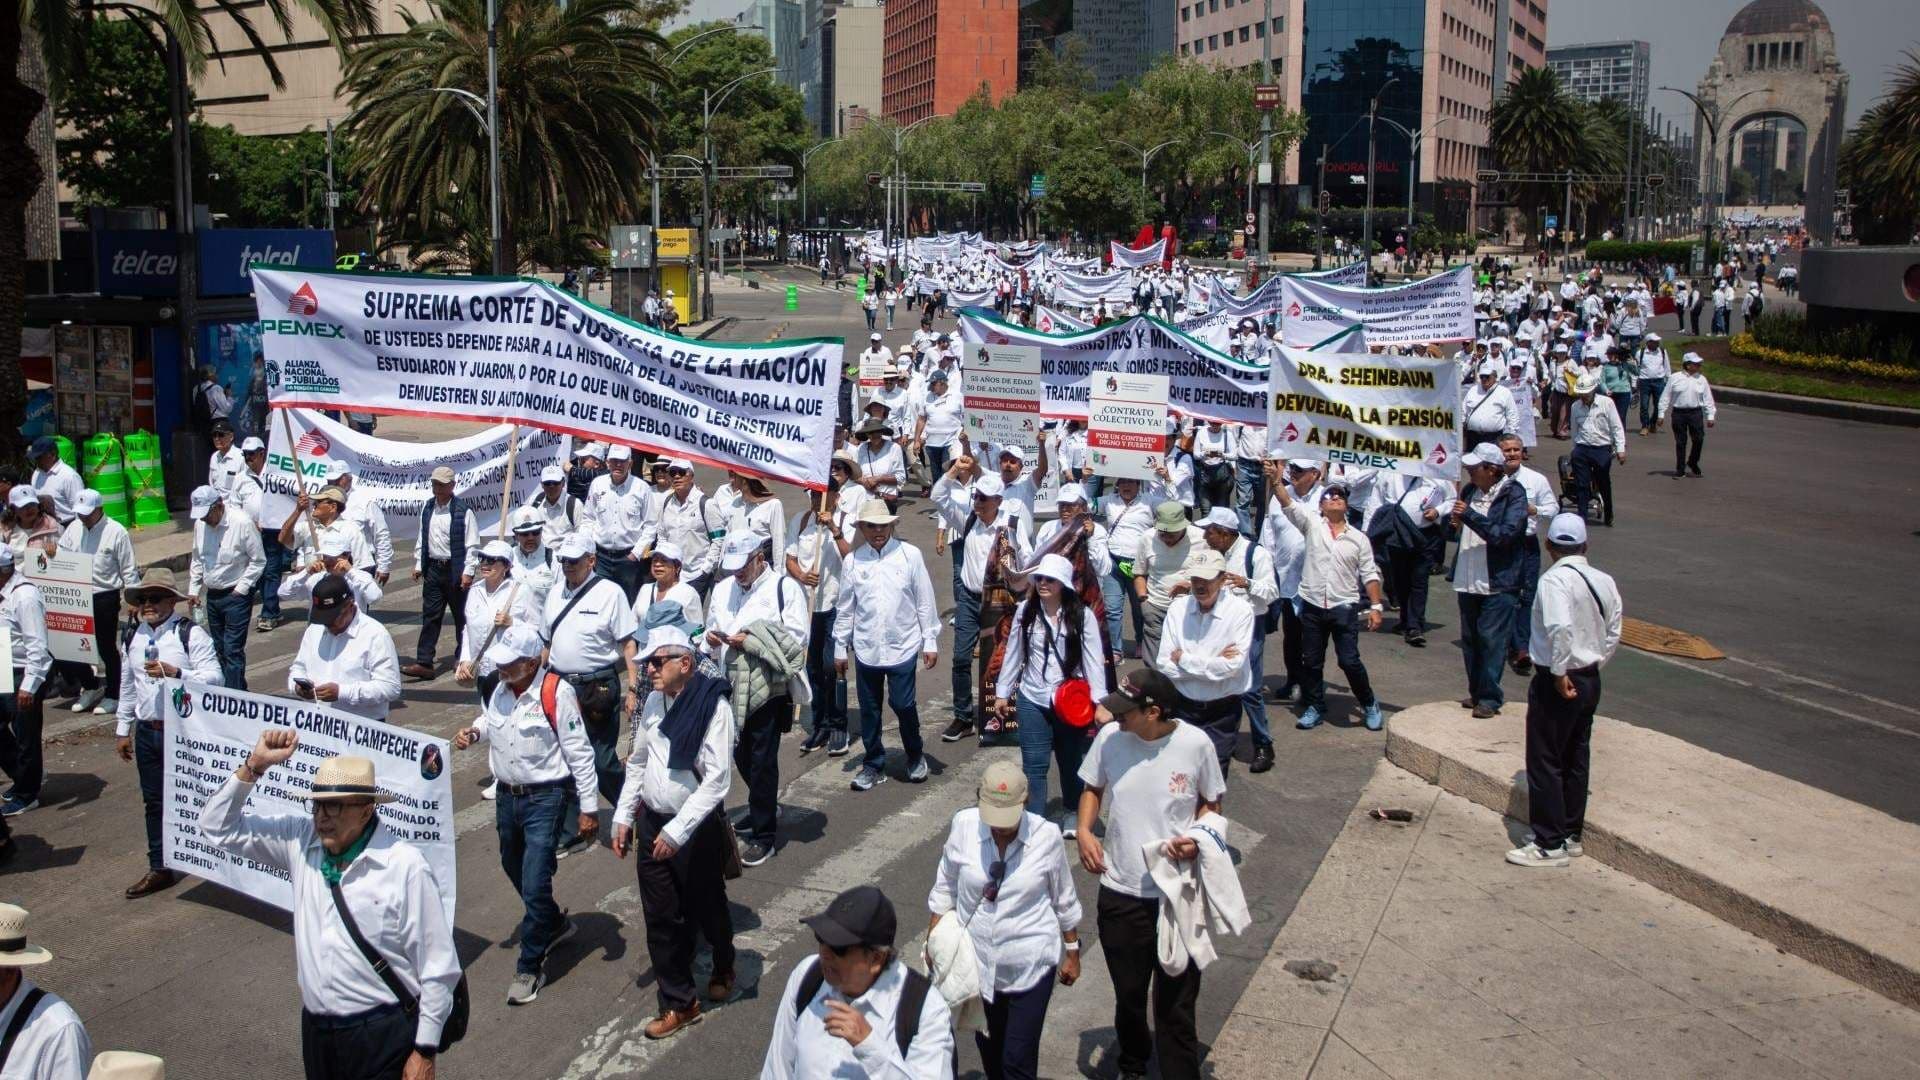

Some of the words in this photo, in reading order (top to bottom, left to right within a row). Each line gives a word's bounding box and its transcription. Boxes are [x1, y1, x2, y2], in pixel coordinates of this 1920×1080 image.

[1324, 161, 1366, 173] ONORA
[1369, 161, 1399, 173] RILL
[1407, 291, 1461, 301] defendiendo
[1303, 306, 1343, 314] PEMEX
[1432, 311, 1462, 319] manos
[259, 319, 345, 339] PEMEX
[1394, 323, 1446, 333] conciencias
[1411, 332, 1430, 340] toda
[364, 291, 464, 321] SUPREMA
[469, 295, 536, 324] CORTE
[540, 299, 570, 330] DE
[572, 312, 663, 364] JUSTICIA
[670, 349, 701, 373] DE
[705, 356, 732, 377] LA
[740, 351, 827, 386] NACIÓN
[1135, 329, 1145, 348] Y
[285, 360, 320, 368] ALIANZA
[285, 368, 327, 376] NACIONAL
[1040, 359, 1055, 375] NO
[1057, 359, 1090, 376] SOMOS
[292, 376, 339, 386] JUBILADOS
[364, 330, 381, 346] DE
[385, 330, 443, 348] USTEDES
[447, 333, 503, 352] DEPENDE
[505, 336, 540, 354] PASAR
[542, 340, 552, 356] A
[556, 342, 573, 361] LA
[576, 346, 634, 376] HISTORIA
[638, 365, 657, 382] DE
[660, 370, 676, 389] LA
[680, 380, 738, 405] JUSTICIA
[742, 392, 770, 410] POR
[774, 395, 791, 412] LA
[795, 398, 823, 416] QUE
[980, 375, 1000, 384] AÑOS
[1013, 378, 1033, 386] EDAD
[1297, 360, 1333, 384] DRA.
[1340, 367, 1435, 389] SHEINBAUM
[988, 385, 1036, 395] ANTIGÜEDAD
[1045, 385, 1091, 402] TRATAMIE
[1169, 385, 1191, 403] QUE
[1194, 387, 1255, 408] DEPENDEN
[377, 356, 456, 376] ESTUDIARON
[460, 361, 468, 376] Y
[470, 361, 516, 383] JUARON,
[519, 364, 527, 380] O
[530, 365, 556, 385] POR
[560, 371, 578, 389] LO
[581, 376, 609, 396] QUE
[612, 382, 629, 401] UN
[633, 388, 699, 419] GOBIERNO
[706, 408, 731, 428] LES
[734, 416, 805, 442] INSTRUYA.
[399, 383, 478, 405] DEMUESTREN
[481, 390, 496, 407] SU
[497, 390, 565, 416] AUTONOMÍA
[570, 402, 598, 422] QUE
[601, 408, 616, 425] EL
[620, 412, 671, 437] PUEBLO
[674, 425, 697, 444] LES
[1101, 405, 1154, 417] ¡CONTRATO
[1275, 392, 1354, 422] DEVUELVA
[1359, 407, 1381, 426] LA
[1387, 406, 1455, 431] PENSIÓN
[1093, 414, 1145, 425] COLECTIVO
[1147, 418, 1162, 427] YA!
[1120, 434, 1157, 443] CONTRATO
[1127, 441, 1153, 449] FUERTE
[1306, 427, 1321, 445] A
[1327, 428, 1348, 448] MI
[1352, 433, 1422, 460] FAMILIA
[269, 453, 327, 478] PEME
[1328, 450, 1399, 470] PEMEX
[474, 463, 509, 486] CASTIGA
[514, 464, 524, 480] AL
[45, 595, 74, 607] ECTIVO
[77, 599, 89, 608] YA!
[56, 615, 87, 625] CONTRATO
[62, 623, 85, 631] FUERTE
[202, 692, 259, 720] CIUDAD
[263, 703, 291, 727] DEL
[295, 709, 352, 746] CARMEN,
[354, 724, 419, 762] CAMPECHE
[224, 746, 237, 757] DE
[175, 750, 204, 766] CRUDO
[211, 759, 231, 771] DEL
[296, 762, 307, 772] ES
[175, 764, 227, 785] PLATAFORM
[268, 771, 281, 782] SU
[422, 800, 439, 810] DE
[256, 784, 261, 793] Y
[375, 803, 440, 827] PENSIONADO,
[175, 793, 188, 804] NO
[414, 831, 440, 841] POR
[174, 837, 180, 845] Y
[185, 838, 228, 862] ESFUERZO,
[231, 855, 243, 866] NO
